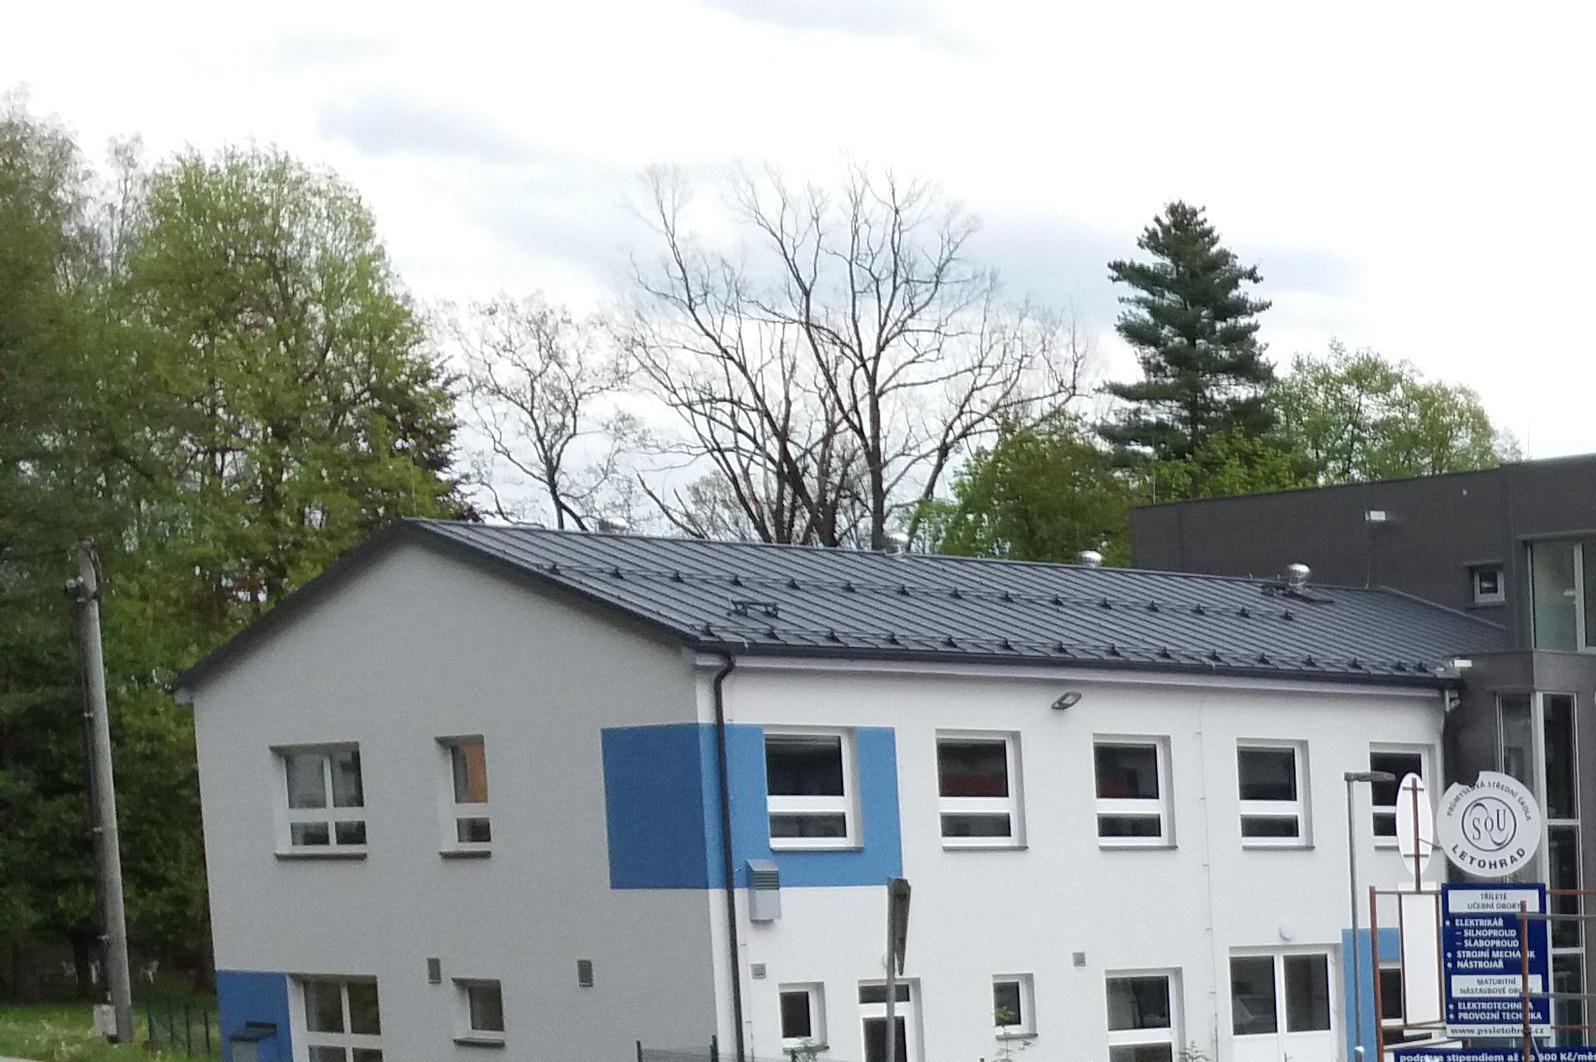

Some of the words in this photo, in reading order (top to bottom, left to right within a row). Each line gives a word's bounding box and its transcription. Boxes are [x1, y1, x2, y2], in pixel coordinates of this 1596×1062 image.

[1451, 844, 1526, 869] LETOHRAD
[1455, 917, 1503, 926] ELEKTRIKÁŘ
[1463, 929, 1516, 937] SILNOPROUD
[1456, 949, 1489, 958] STROJNÍ
[1492, 950, 1535, 958] MECHAIK
[1457, 959, 1503, 968] NÁSTROJAŘ
[1458, 1011, 1499, 1020] PROVOZNÍ
[1446, 1053, 1504, 1062] stipendiem
[1507, 1053, 1519, 1061] až
